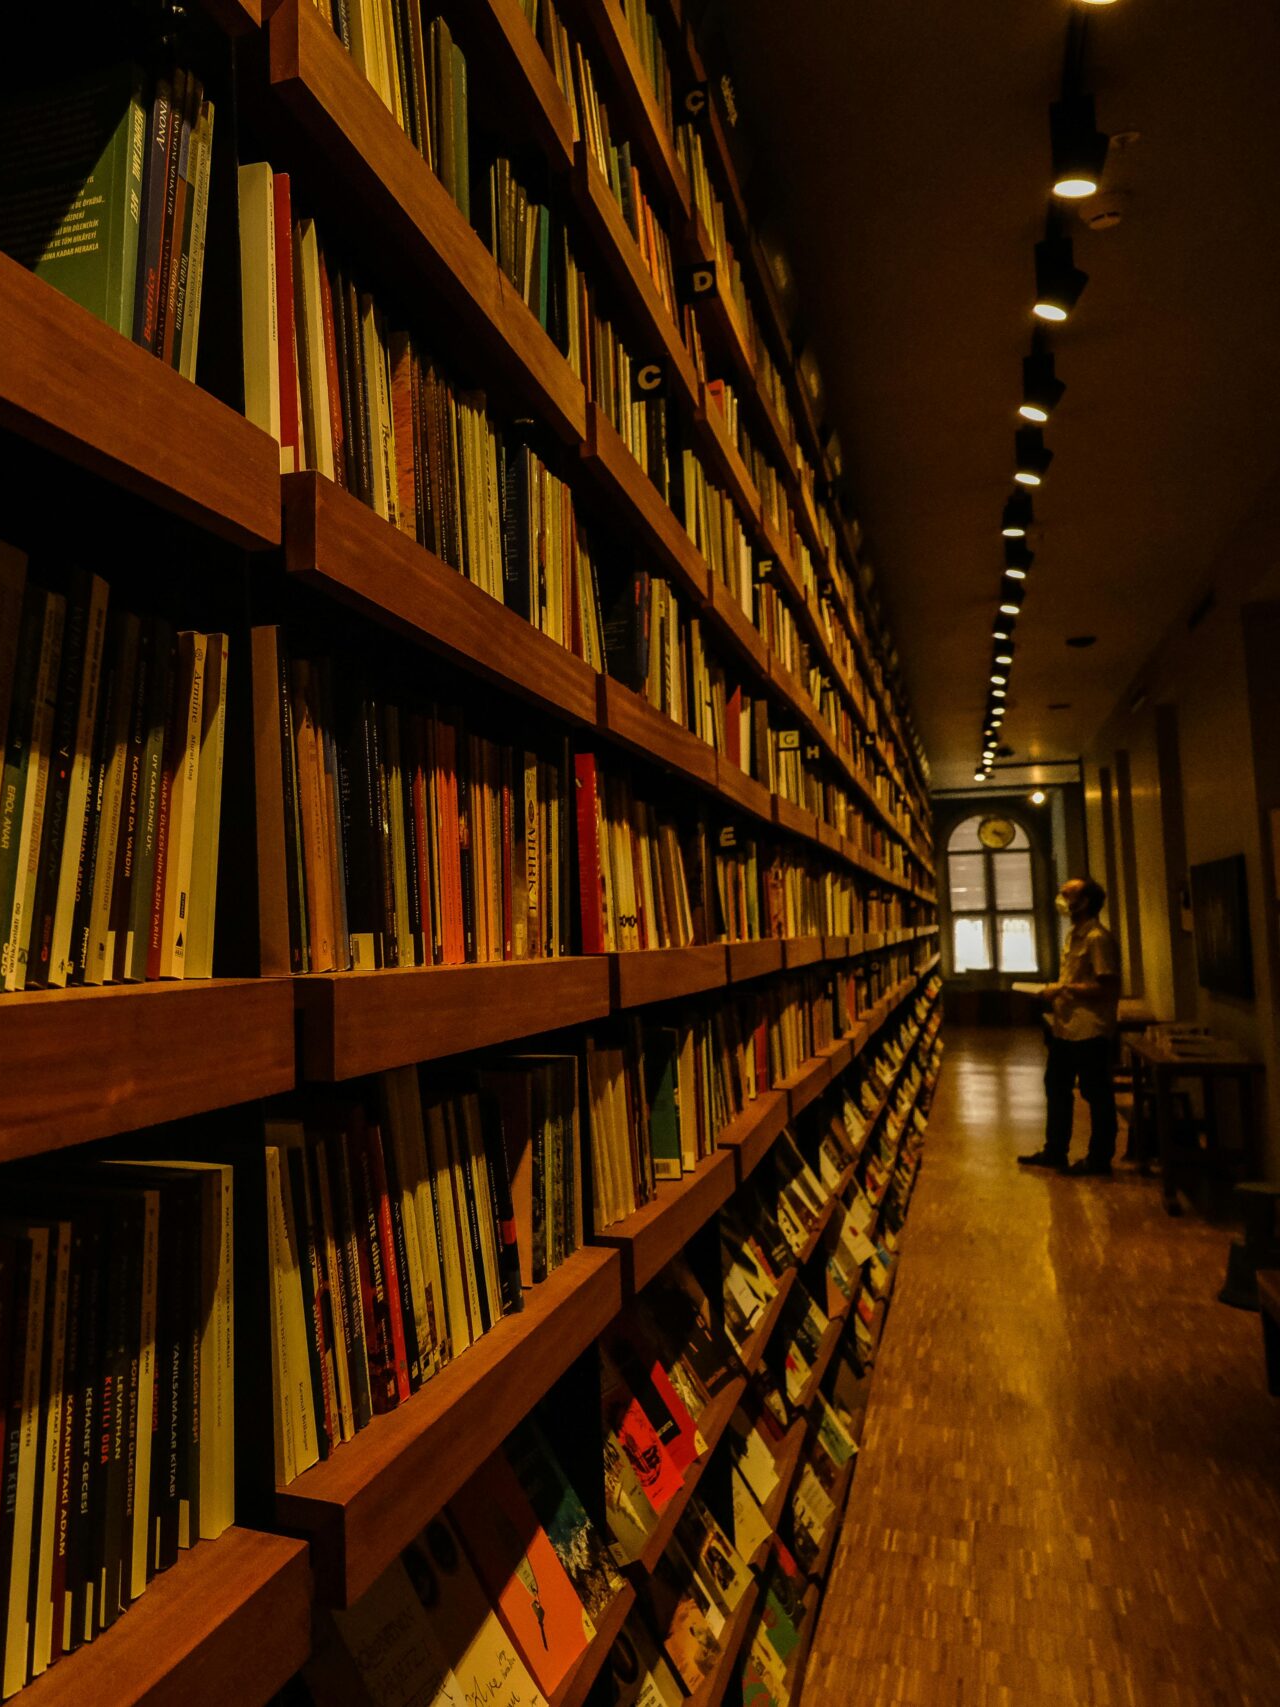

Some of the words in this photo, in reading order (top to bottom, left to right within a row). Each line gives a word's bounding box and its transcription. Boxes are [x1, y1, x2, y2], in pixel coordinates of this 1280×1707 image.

[129, 188, 143, 224] AFET
[693, 270, 714, 292] D
[637, 364, 662, 391] C
[758, 560, 773, 578] F
[190, 671, 202, 724] Armine
[151, 753, 159, 768] UY
[806, 745, 820, 760] H
[4, 784, 17, 814] EROL
[128, 755, 140, 813] KADINLAR
[146, 770, 158, 832] KARADENİZ
[0, 816, 13, 850] ANAR
[127, 816, 135, 833] DA
[719, 826, 737, 848] E
[123, 836, 134, 879] VARDIR
[154, 875, 165, 910] HAZİN
[151, 913, 161, 949] TARİHİ
[129, 1359, 138, 1388] SON
[168, 1343, 181, 1449] YANILSAMALAR
[81, 1387, 95, 1457] KEHANET
[113, 1376, 125, 1461] LEVIATHAN
[50, 1439, 58, 1473] ADAM
[60, 1394, 75, 1506] KARANLIKTAKİ
[79, 1461, 91, 1515] GECESİ
[168, 1453, 179, 1499] KİTABI
[57, 1509, 69, 1558] ADAM
